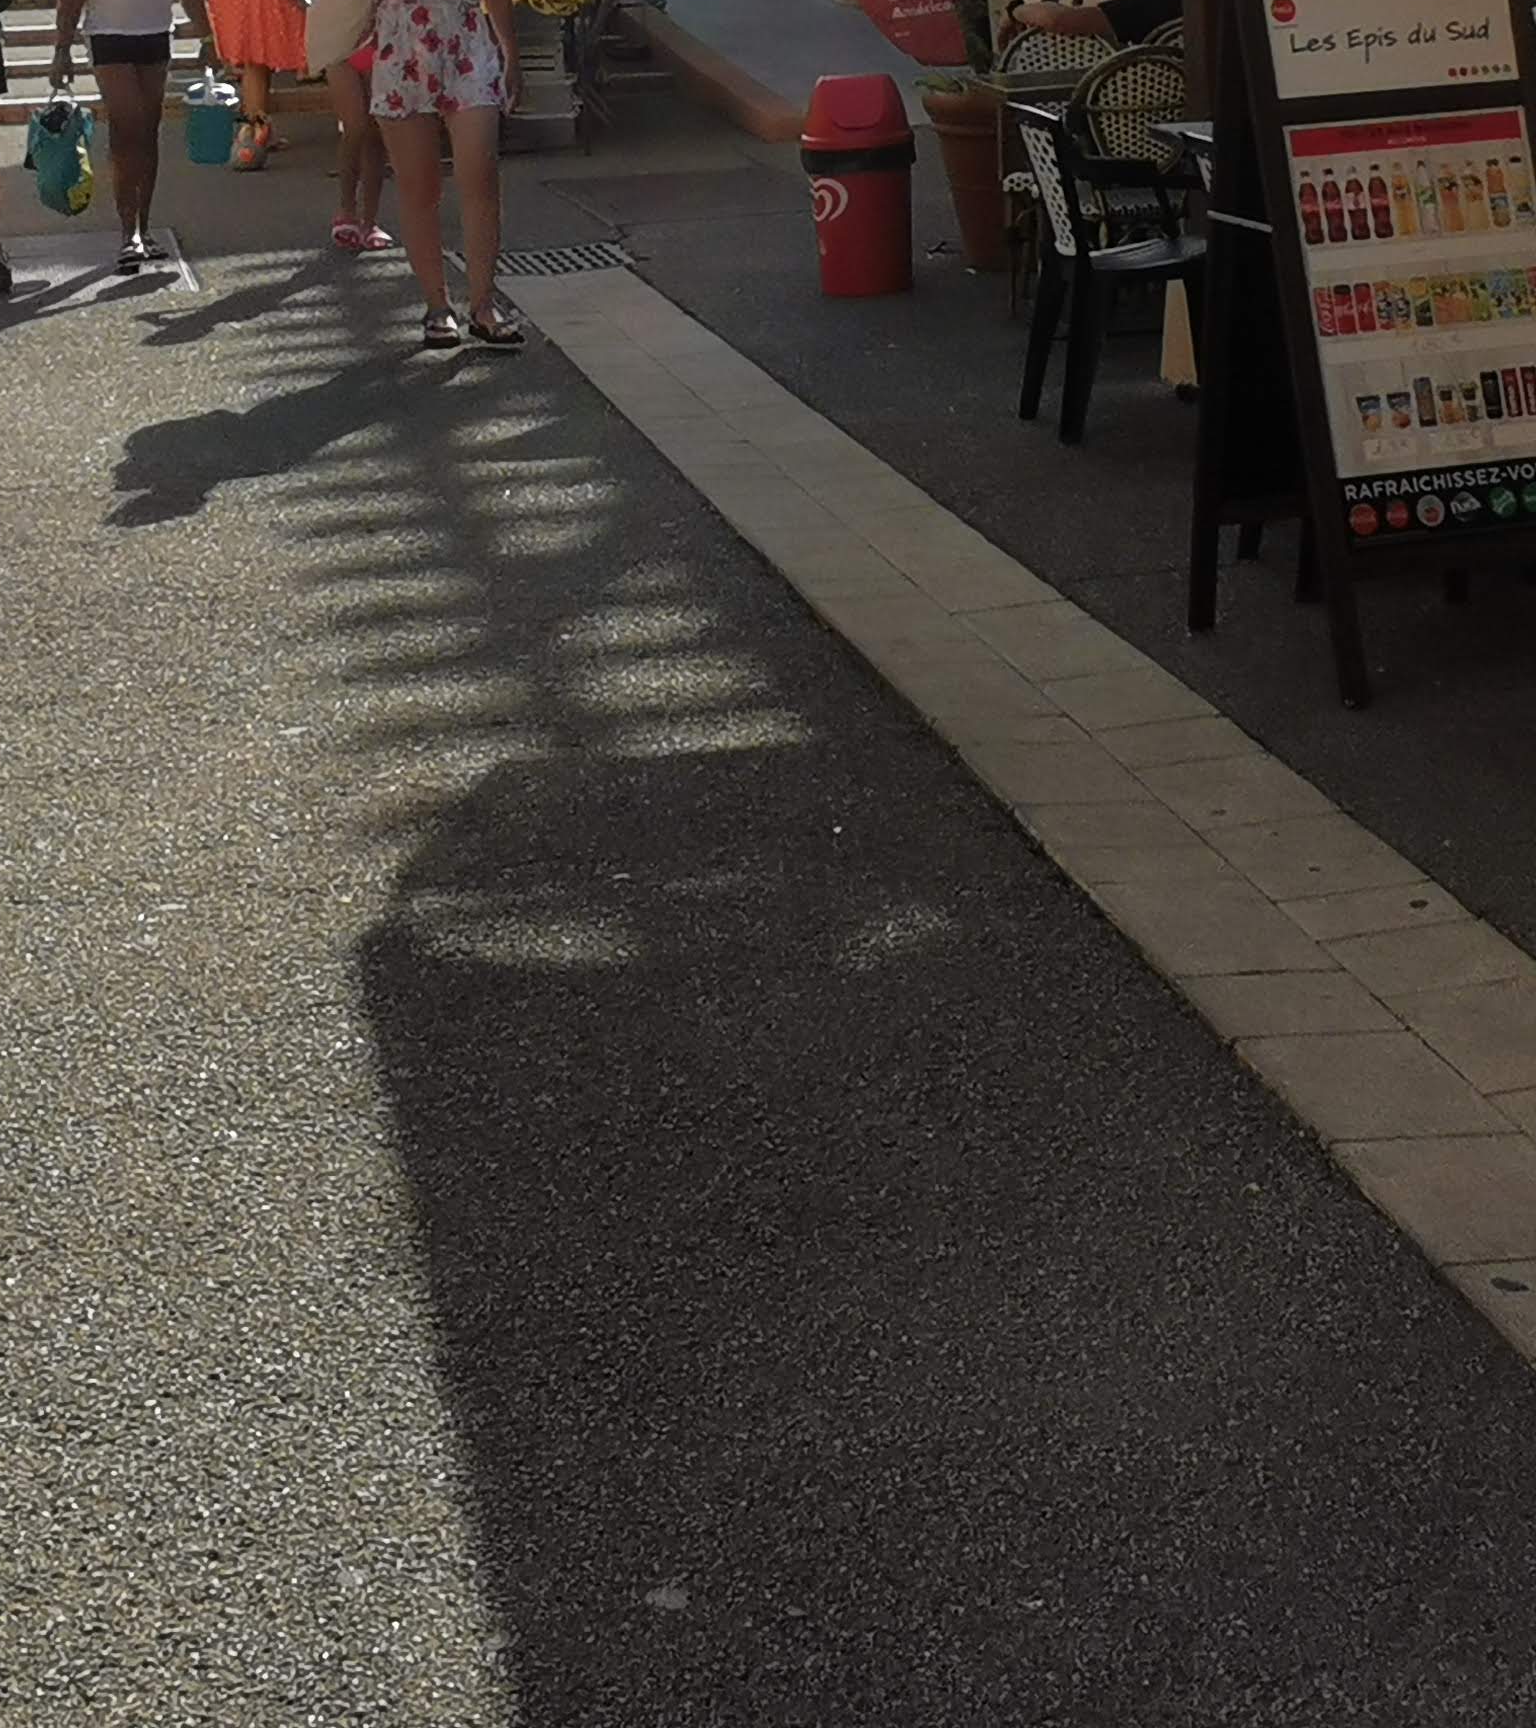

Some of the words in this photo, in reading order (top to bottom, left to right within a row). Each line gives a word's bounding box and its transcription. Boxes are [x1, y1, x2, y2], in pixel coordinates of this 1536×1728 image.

[1289, 32, 1336, 55] Les
[1347, 27, 1398, 64] Epis
[1407, 21, 1437, 46] du
[1446, 16, 1491, 42] Sud
